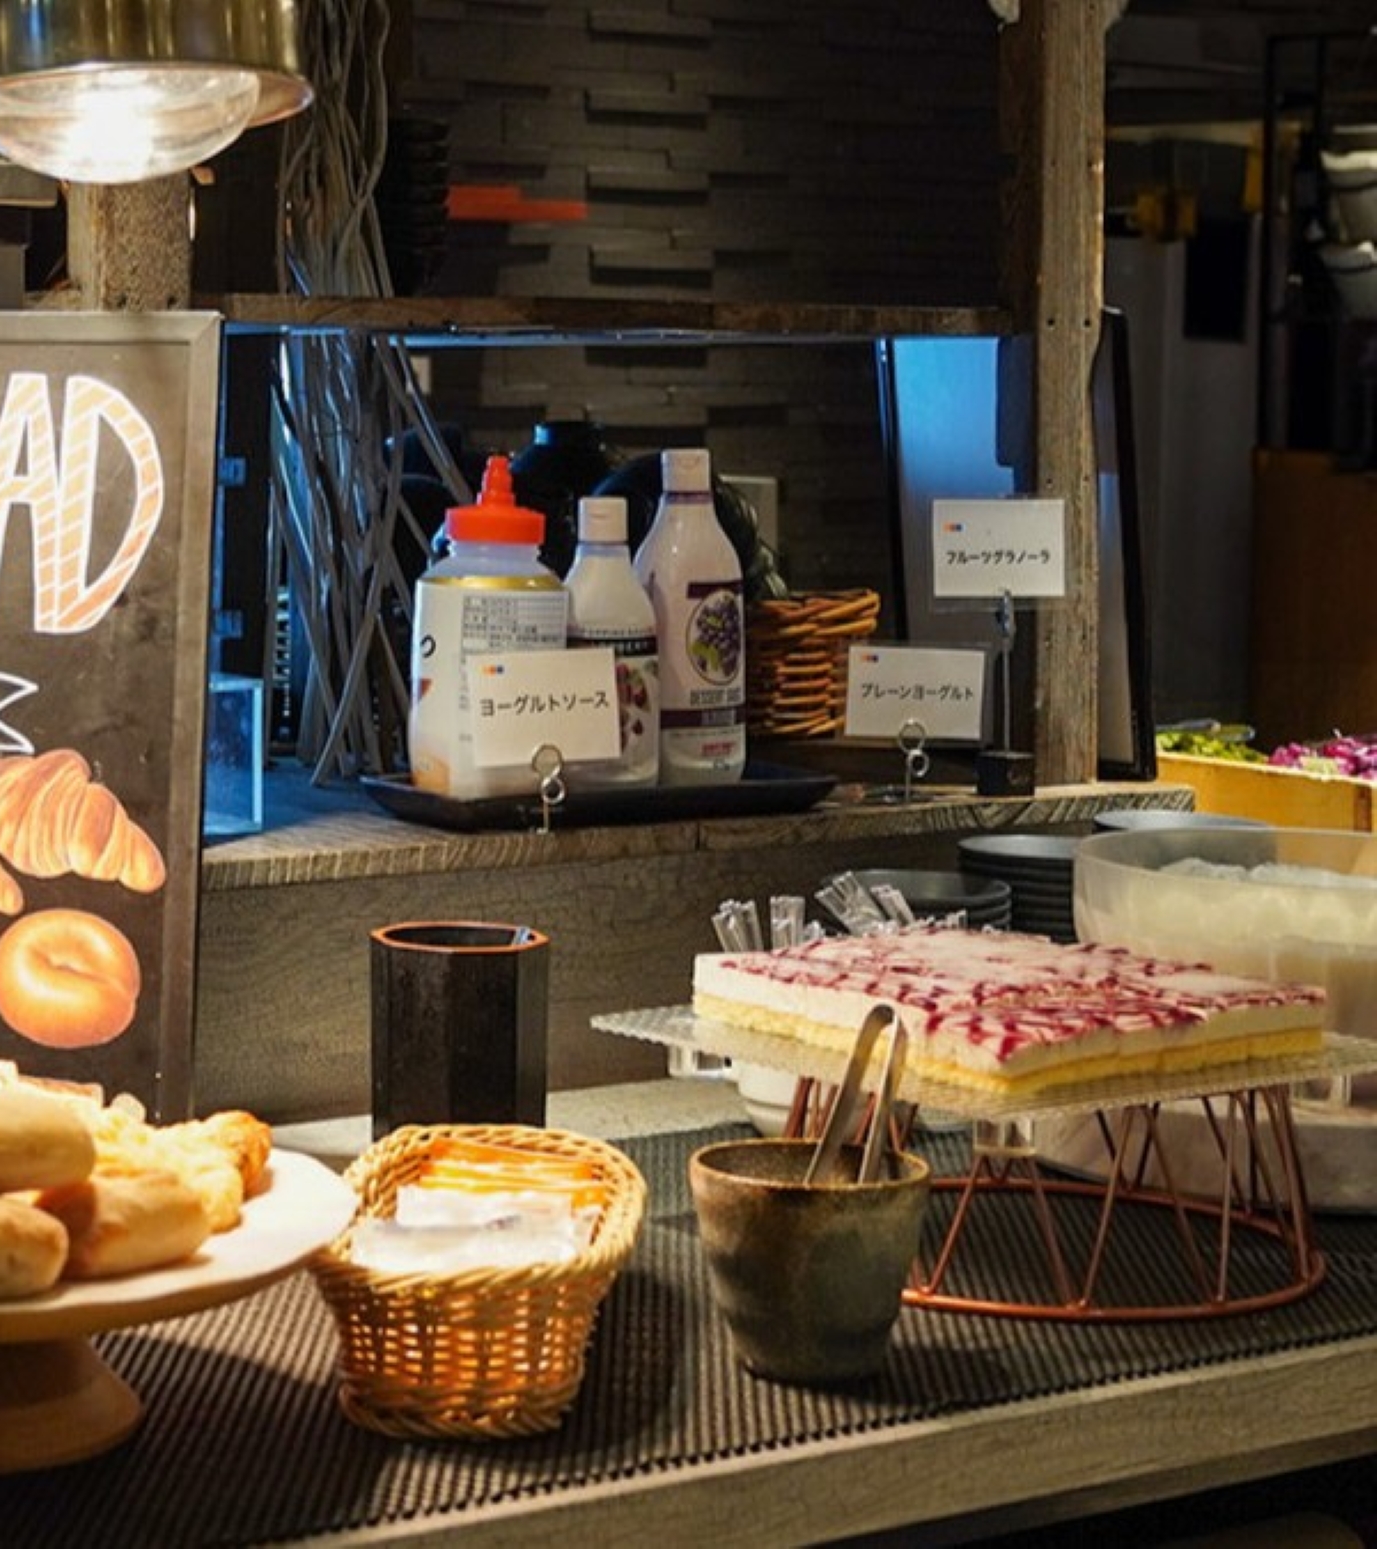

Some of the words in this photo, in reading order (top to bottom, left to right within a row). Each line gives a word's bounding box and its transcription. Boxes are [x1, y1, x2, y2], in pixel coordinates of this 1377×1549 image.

[946, 550, 1051, 565] フルーツグラノーラ
[862, 683, 974, 701] プレーンヨーグルト
[479, 690, 611, 717] ヨーグルトソース
